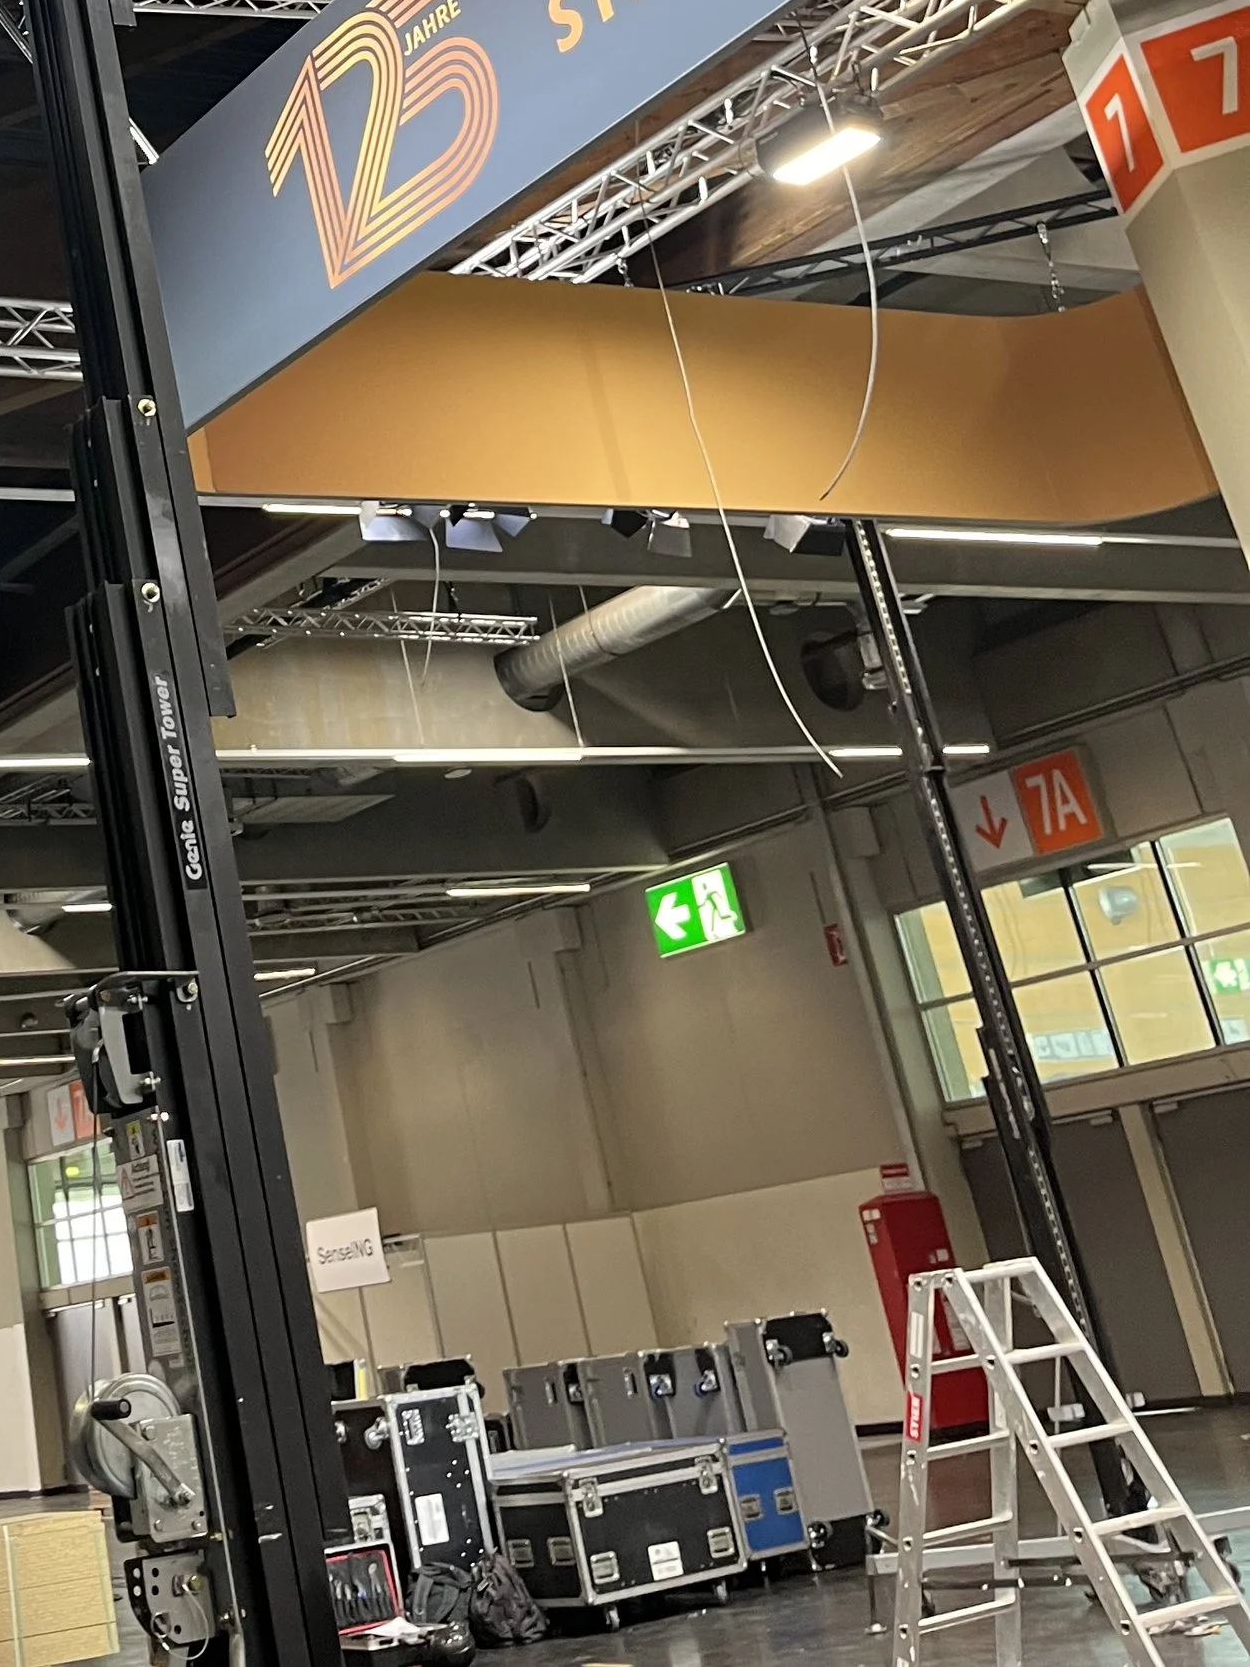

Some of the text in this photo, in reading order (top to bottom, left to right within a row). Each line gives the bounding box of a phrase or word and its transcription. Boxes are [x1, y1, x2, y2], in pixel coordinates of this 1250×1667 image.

[1190, 36, 1238, 115] 7
[155, 675, 203, 881] Genie Super Tower
[1025, 768, 1088, 836] 7A
